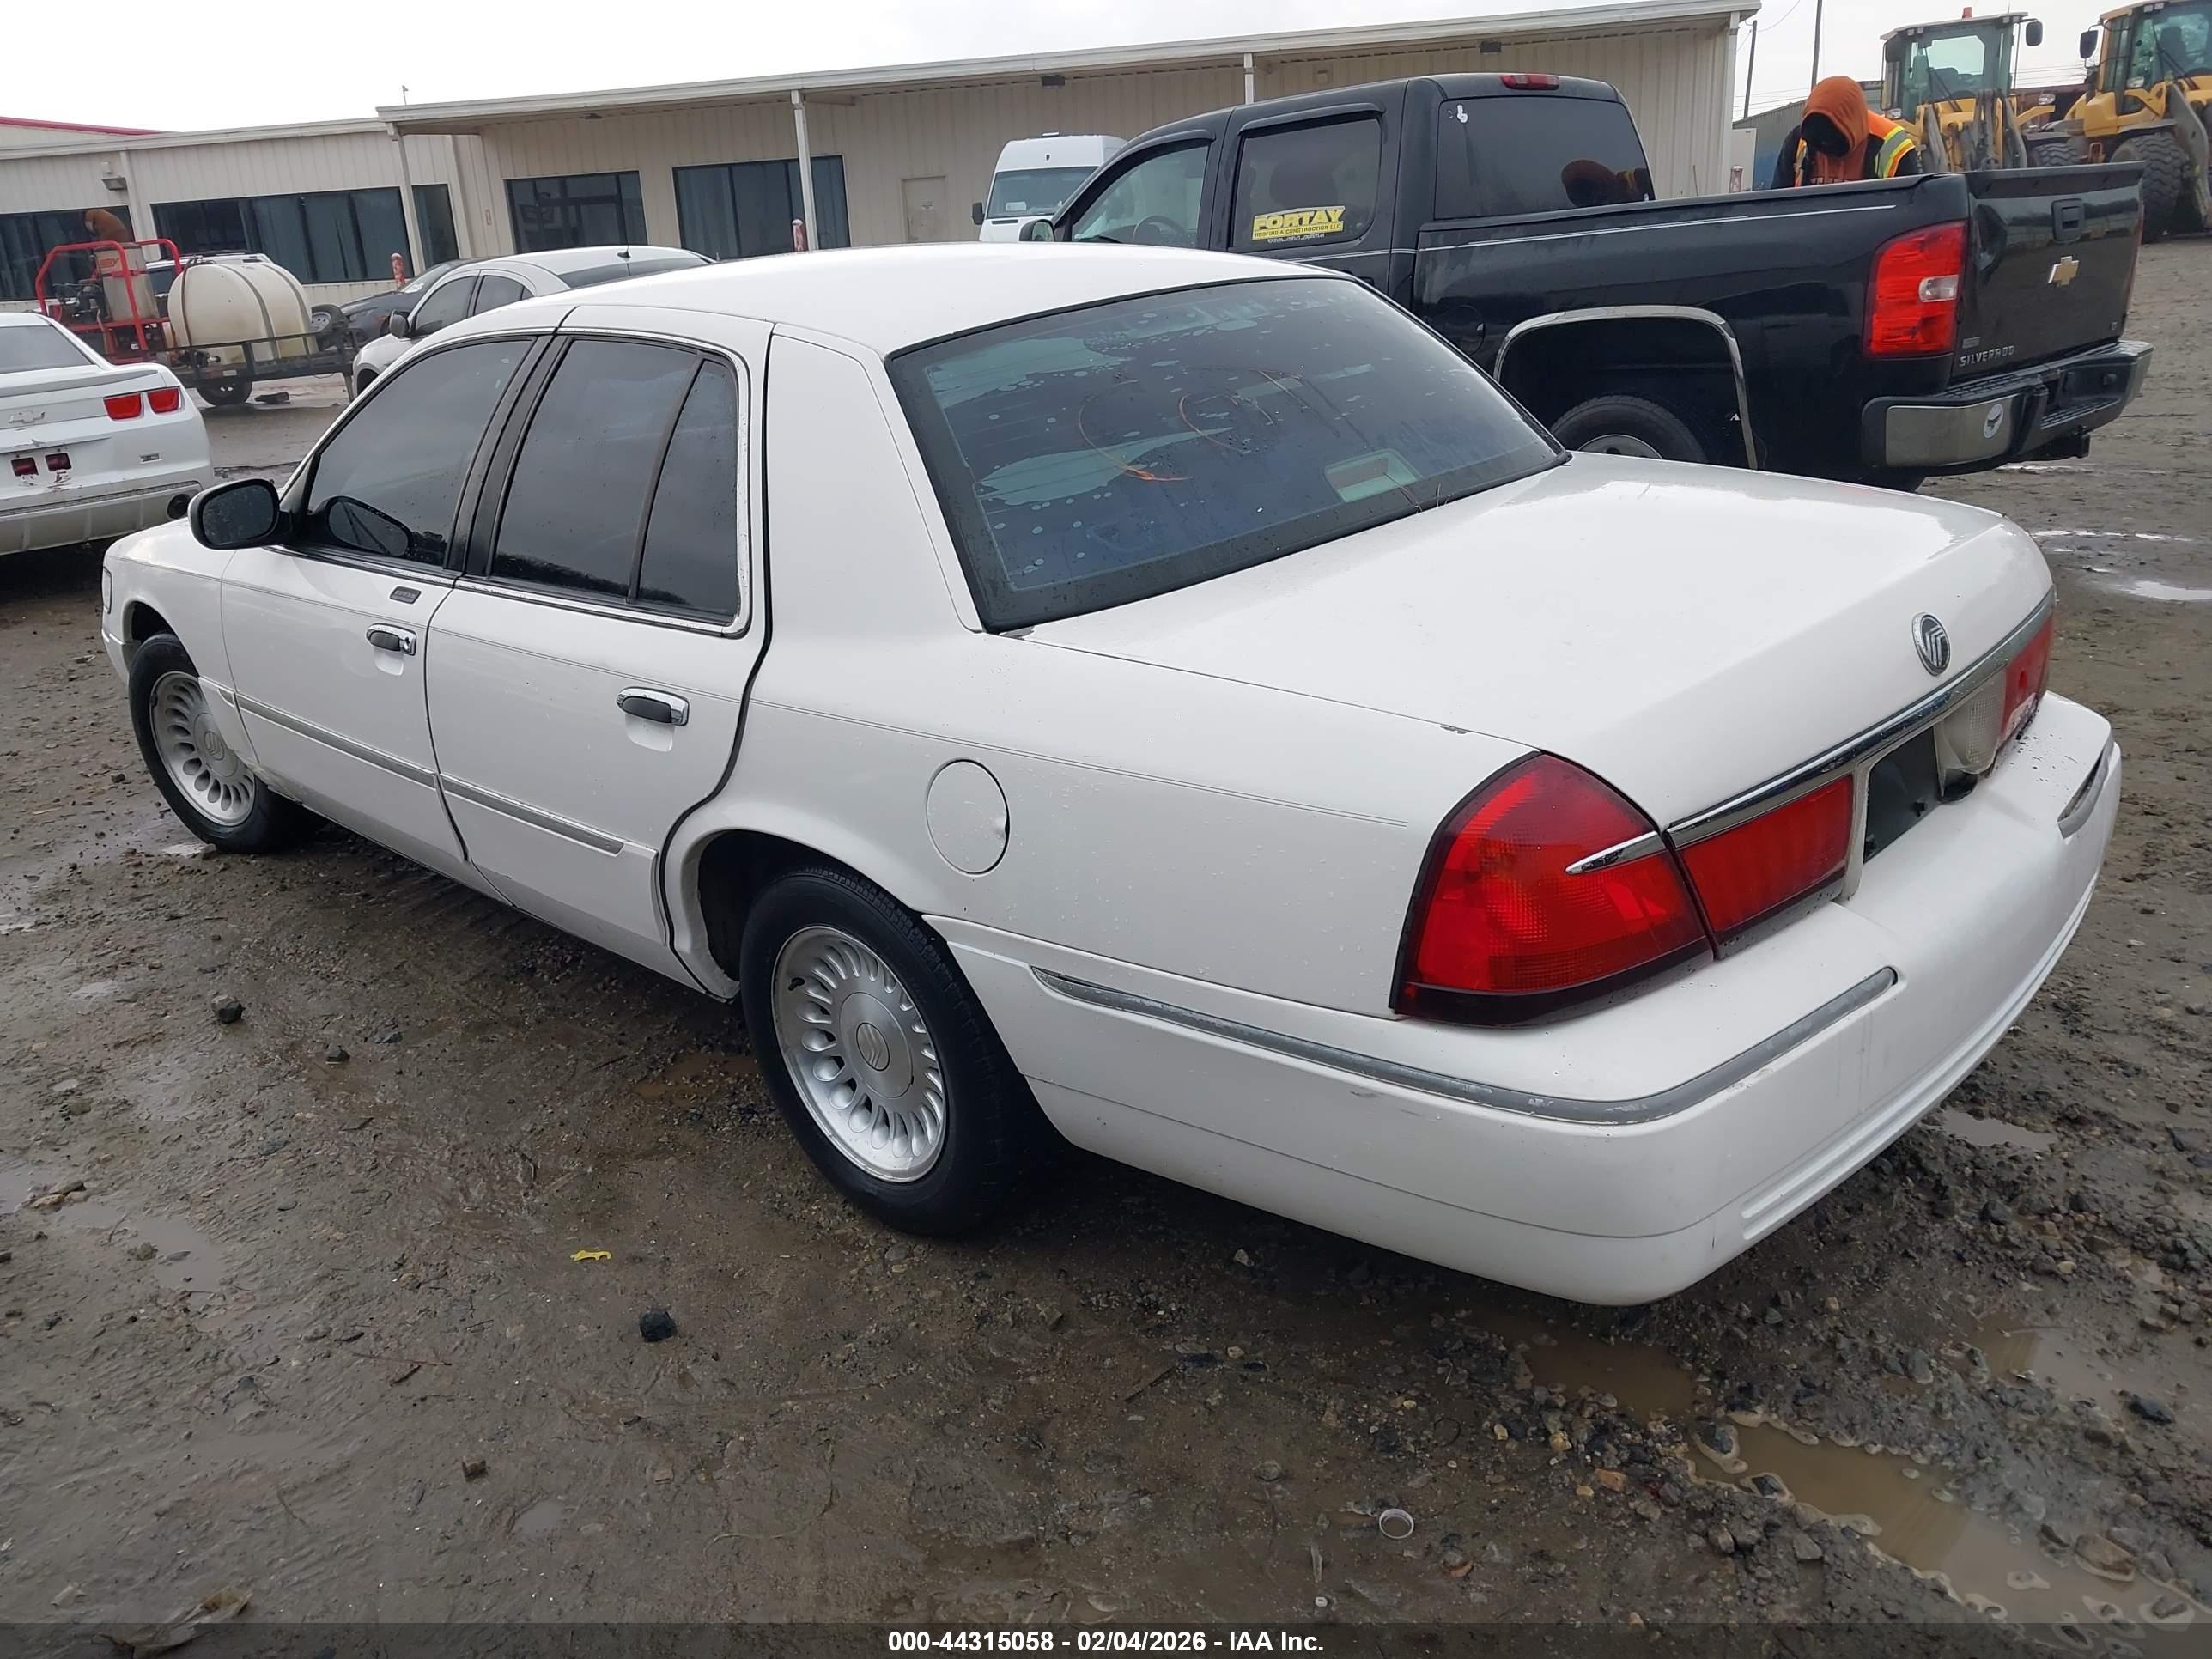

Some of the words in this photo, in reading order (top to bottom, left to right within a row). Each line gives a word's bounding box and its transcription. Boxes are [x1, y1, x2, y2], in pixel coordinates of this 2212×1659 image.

[1254, 206, 1345, 230] FORTAY
[1285, 225, 1329, 234] CONSTRUCTION
[1959, 345, 2015, 367] SILVERADO
